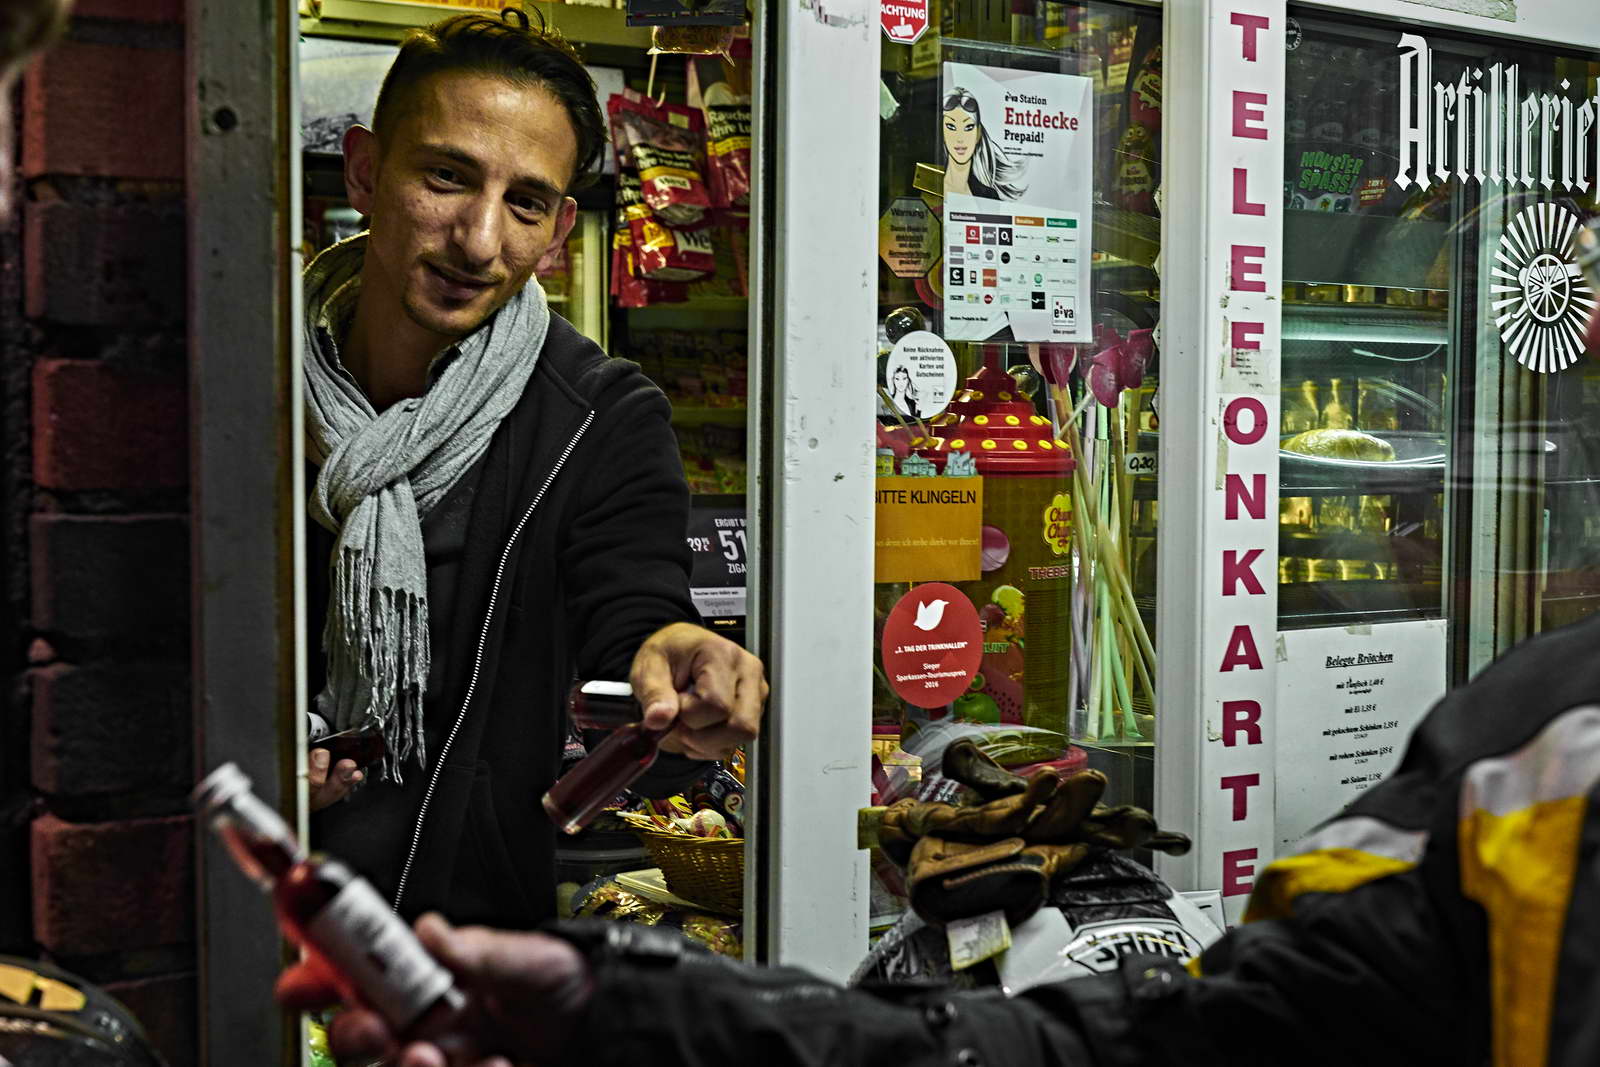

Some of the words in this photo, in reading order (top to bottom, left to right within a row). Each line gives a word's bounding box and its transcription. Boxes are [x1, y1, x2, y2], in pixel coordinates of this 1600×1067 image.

[880, 4, 926, 20] ACHTUNG
[1019, 94, 1047, 105] Station
[1004, 107, 1079, 131] Entdecke
[1004, 129, 1045, 144] Prepaid!
[910, 489, 977, 505] KLINGELN
[904, 645, 915, 653] TAG
[915, 644, 927, 652] DER
[1325, 655, 1355, 668] Belegte
